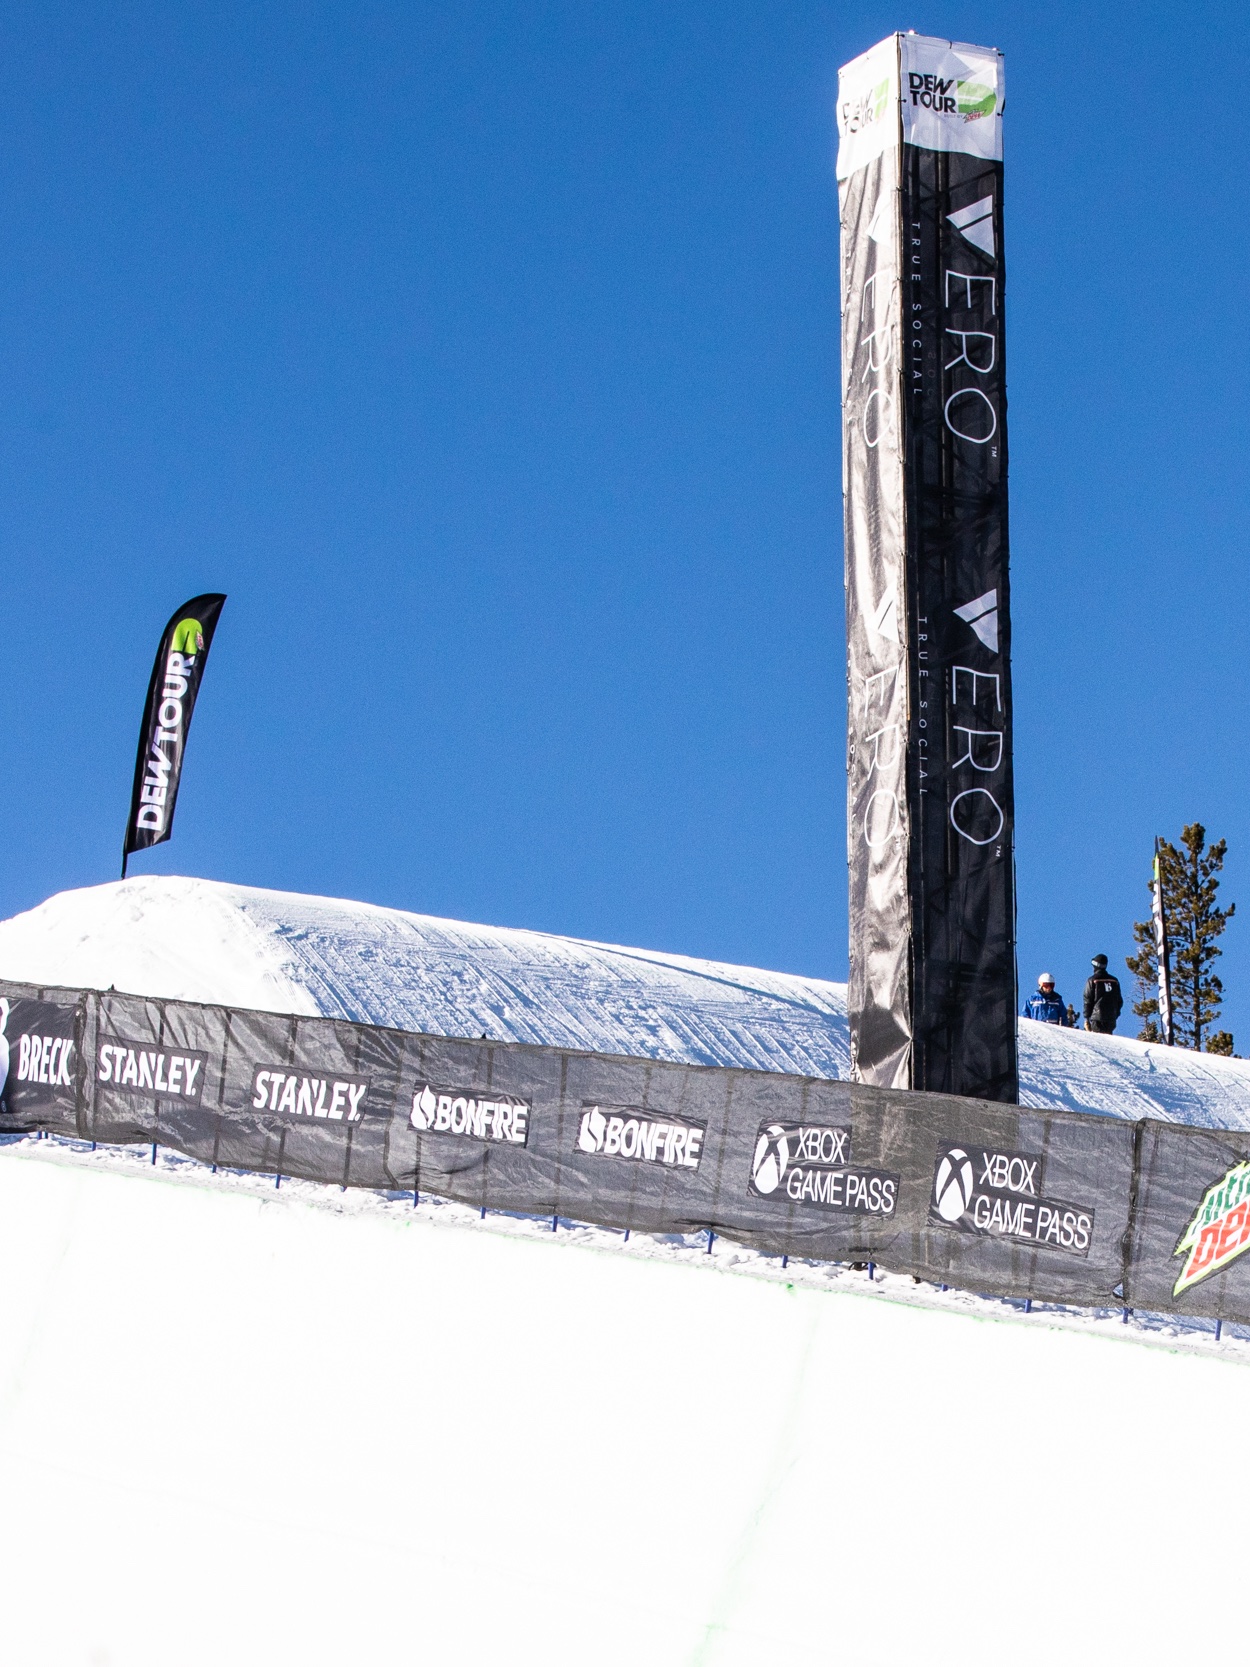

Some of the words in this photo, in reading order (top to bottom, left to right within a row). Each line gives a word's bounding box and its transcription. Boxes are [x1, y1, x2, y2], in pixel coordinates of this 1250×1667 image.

[908, 72, 954, 96] DEW
[910, 90, 956, 114] TOUR
[912, 222, 921, 282] TRUE
[912, 303, 923, 395] SOCIAL
[917, 616, 928, 677] TRUE
[136, 741, 172, 831] DEW
[155, 651, 196, 742] TOUR
[918, 701, 928, 794] SOCIAL
[18, 1034, 73, 1085] BRECK
[434, 1096, 528, 1143] BONFIRE
[603, 1116, 703, 1167] BONFIRE
[795, 1127, 847, 1164] XBOX
[787, 1167, 844, 1206] GAME
[846, 1174, 895, 1213] PASS
[979, 1152, 1037, 1194] XBOX
[974, 1194, 1035, 1238] GAME
[1035, 1206, 1091, 1249] PASS
